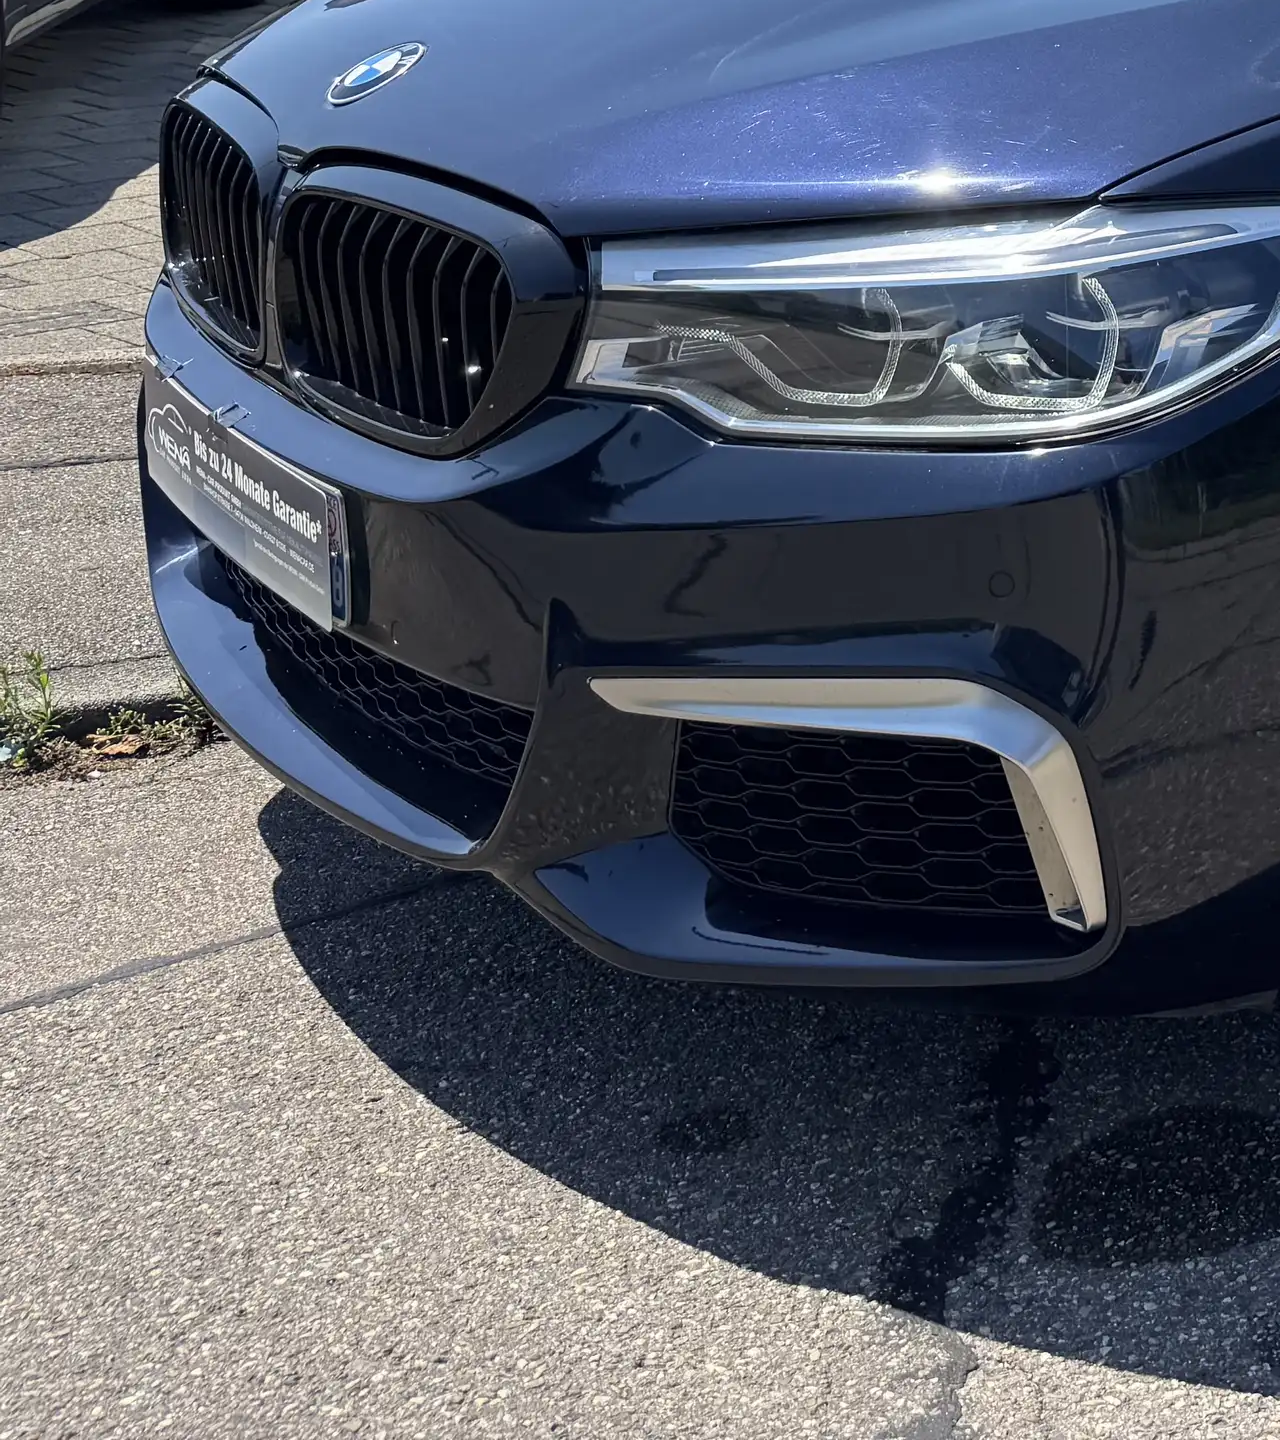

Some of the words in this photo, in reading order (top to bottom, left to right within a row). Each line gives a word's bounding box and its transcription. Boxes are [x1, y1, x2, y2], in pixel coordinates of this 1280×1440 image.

[193, 430, 207, 463] Bis
[208, 448, 220, 472] zu
[220, 453, 233, 483] 24
[234, 462, 271, 511] Monate
